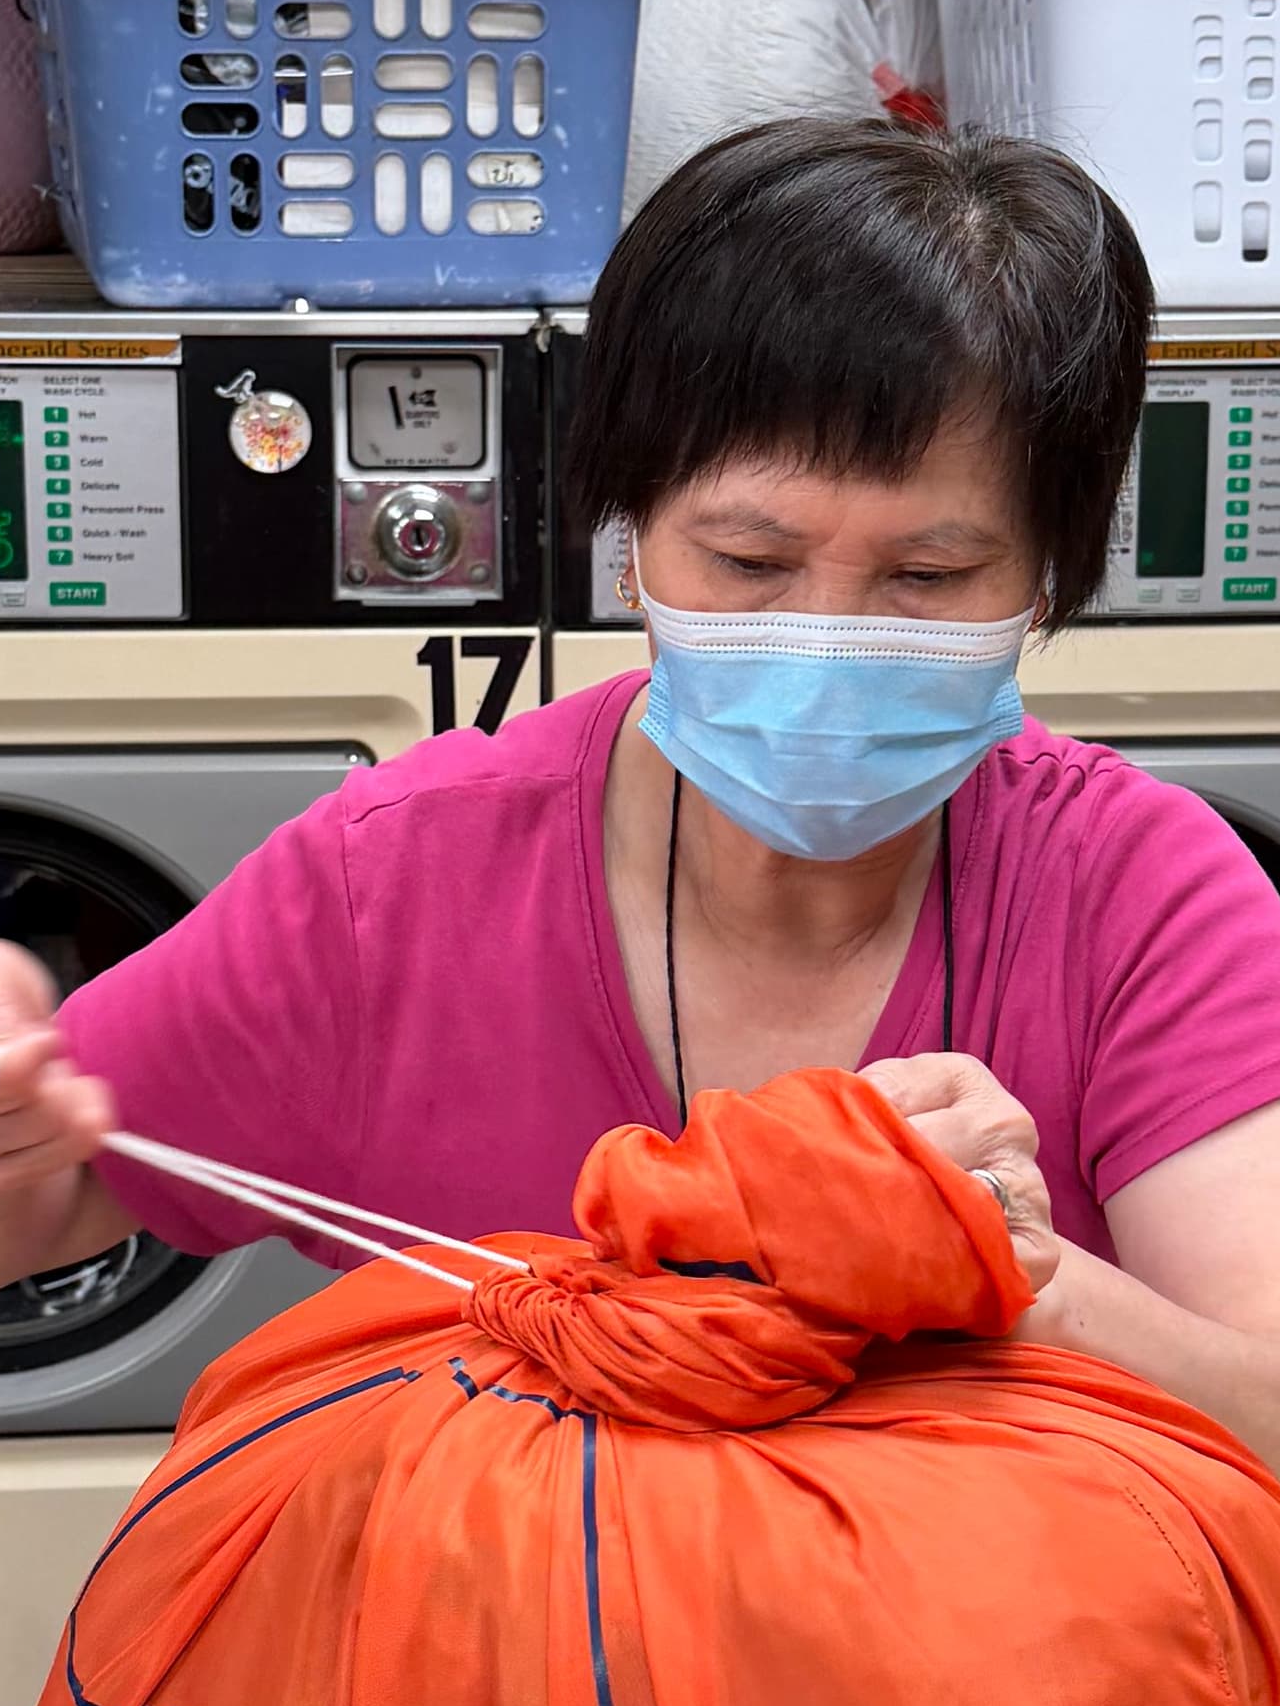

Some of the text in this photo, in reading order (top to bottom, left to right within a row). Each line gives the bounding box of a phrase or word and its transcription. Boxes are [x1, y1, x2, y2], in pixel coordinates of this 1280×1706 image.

[77, 341, 151, 358] Series
[1161, 340, 1257, 359] Emerald
[43, 376, 79, 385] SELECT
[52, 410, 96, 419] 1 Hot
[1262, 410, 1278, 419] Hot
[52, 433, 108, 443] 2 Warm
[1236, 434, 1244, 443] 2
[53, 457, 104, 467] 3 Cold
[1235, 457, 1243, 466] 3
[54, 481, 120, 491] 4 Delicate
[1234, 480, 1242, 489] 4
[55, 505, 165, 515] 5 Permanent Press
[1233, 503, 1241, 512] 5
[56, 529, 147, 539] 6 Quick Wash
[1232, 526, 1240, 535] 6
[57, 552, 134, 563] 7 Heavy Soil
[57, 588, 99, 599] START
[1230, 584, 1270, 594] START
[416, 635, 536, 737] 17
